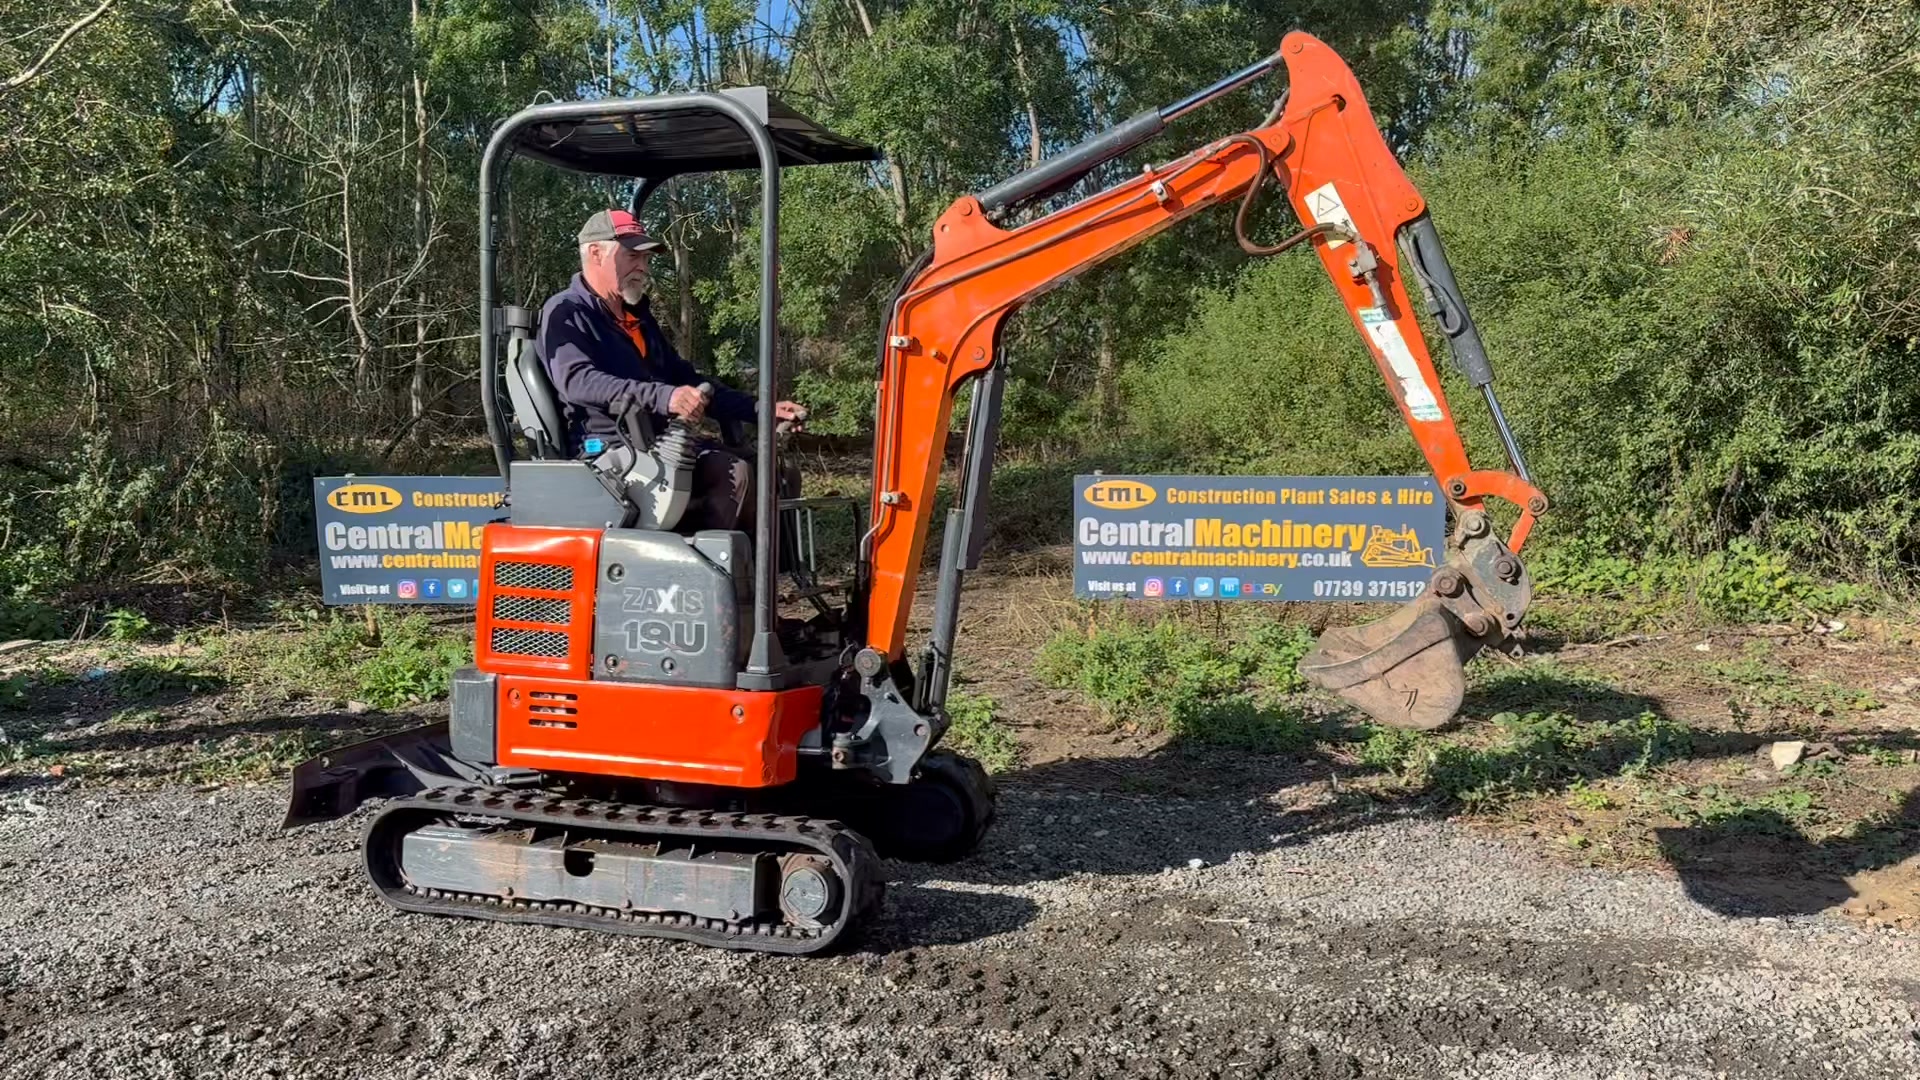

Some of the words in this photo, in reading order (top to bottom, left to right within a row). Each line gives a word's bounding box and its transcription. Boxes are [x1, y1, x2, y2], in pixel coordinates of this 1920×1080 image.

[1166, 487, 1276, 504] Construction
[1280, 488, 1325, 505] Plant
[1329, 488, 1377, 505] Sales
[1381, 490, 1393, 505] &
[1397, 488, 1434, 505] Hire
[1078, 516, 1367, 551] CentralMachinery
[1081, 550, 1353, 569] www.centralmachinery.co.uk
[339, 583, 365, 596] Visit
[365, 584, 379, 595] us
[379, 583, 391, 595] at
[1087, 580, 1110, 592] Visit
[1111, 581, 1125, 592] us
[1125, 581, 1137, 592] at
[1242, 581, 1283, 597] ebay
[1313, 580, 1364, 597] 07739
[1367, 580, 1426, 598] 371512
[623, 584, 705, 616] ZAXIS
[623, 619, 708, 656] 19U
